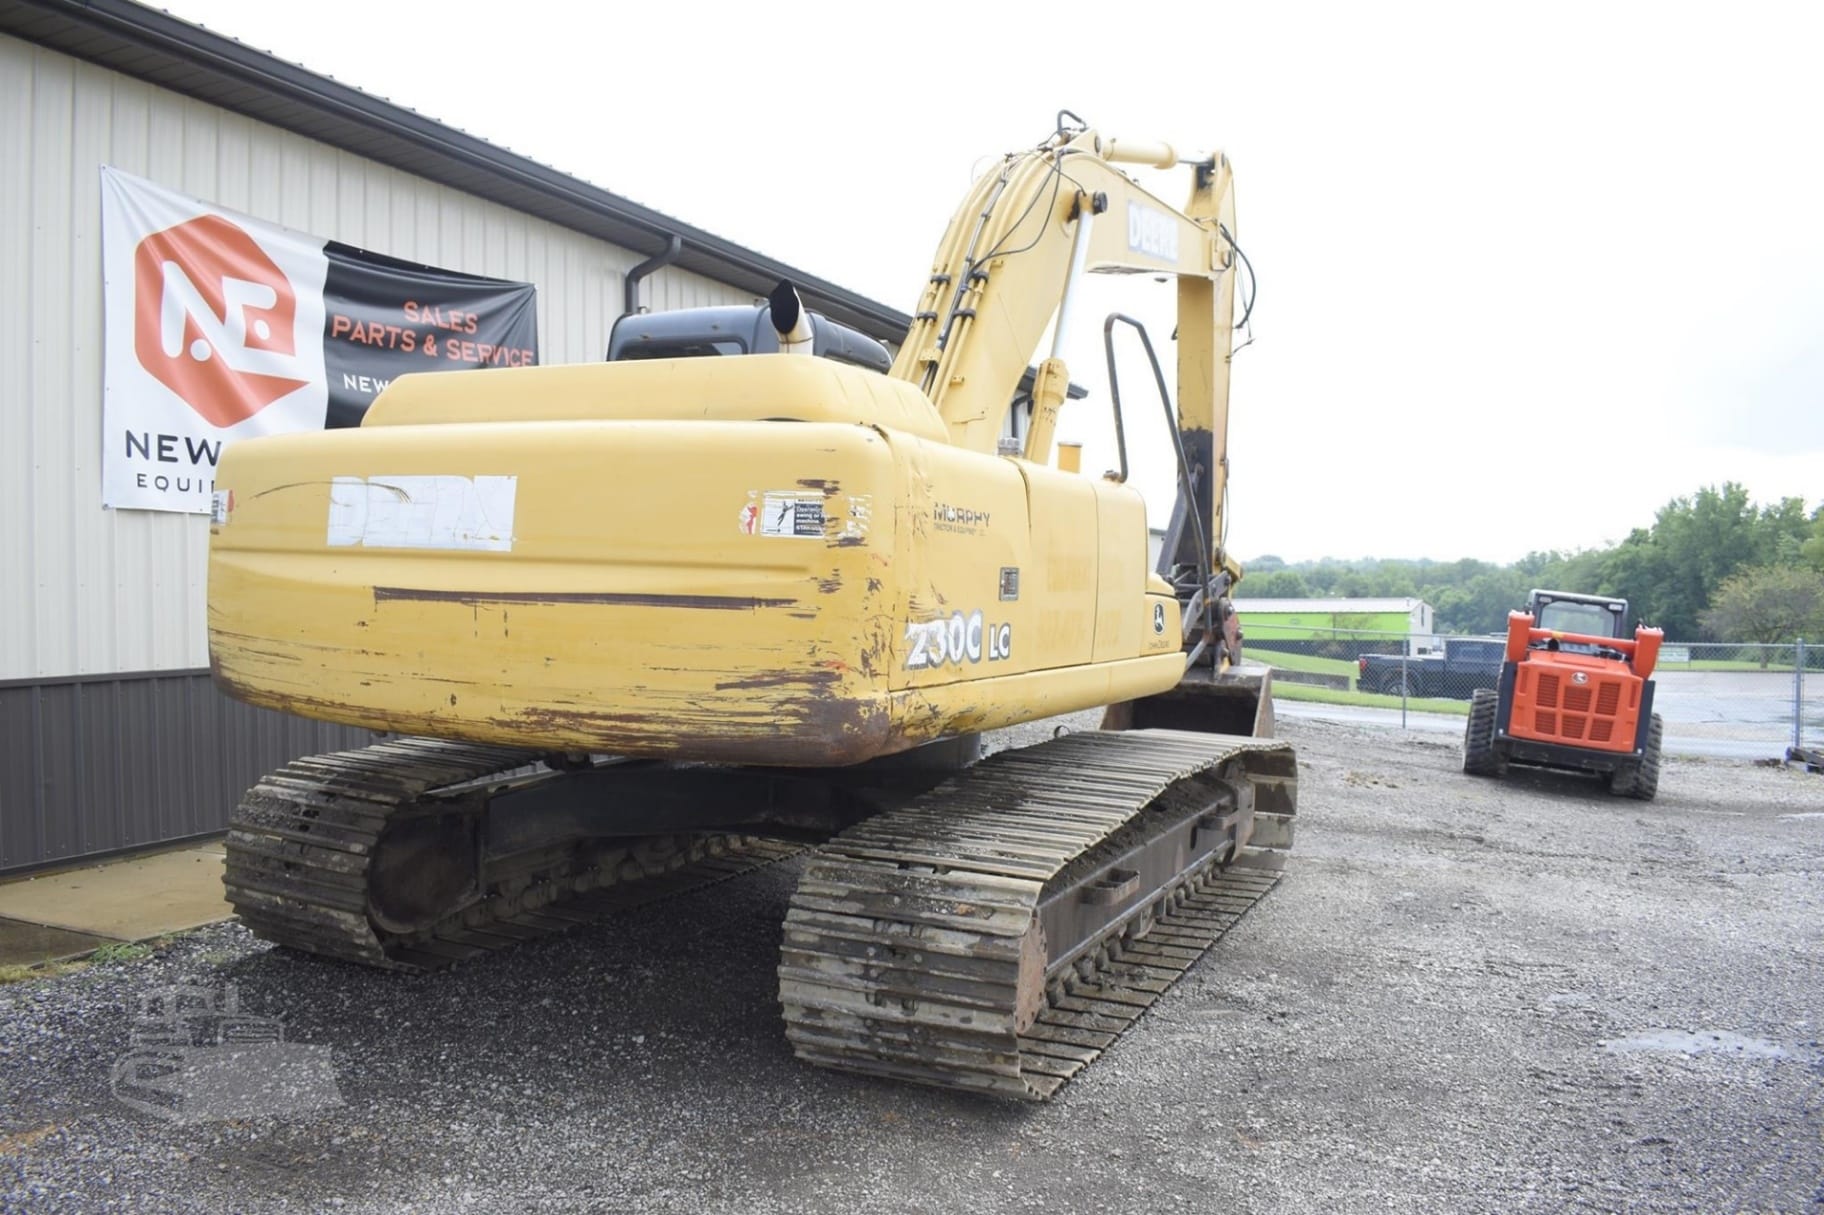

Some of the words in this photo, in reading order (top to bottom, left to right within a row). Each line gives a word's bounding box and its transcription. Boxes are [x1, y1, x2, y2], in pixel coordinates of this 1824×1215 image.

[403, 301, 479, 334] SALES
[331, 315, 416, 352] PARTS
[423, 334, 438, 357] &
[446, 339, 534, 367] SERVICE
[343, 374, 389, 394] NEW
[125, 429, 222, 467] NEW
[136, 473, 215, 493] EQUI
[933, 502, 990, 528] MURPHY
[905, 609, 983, 669] 230C
[988, 622, 1011, 662] LC
